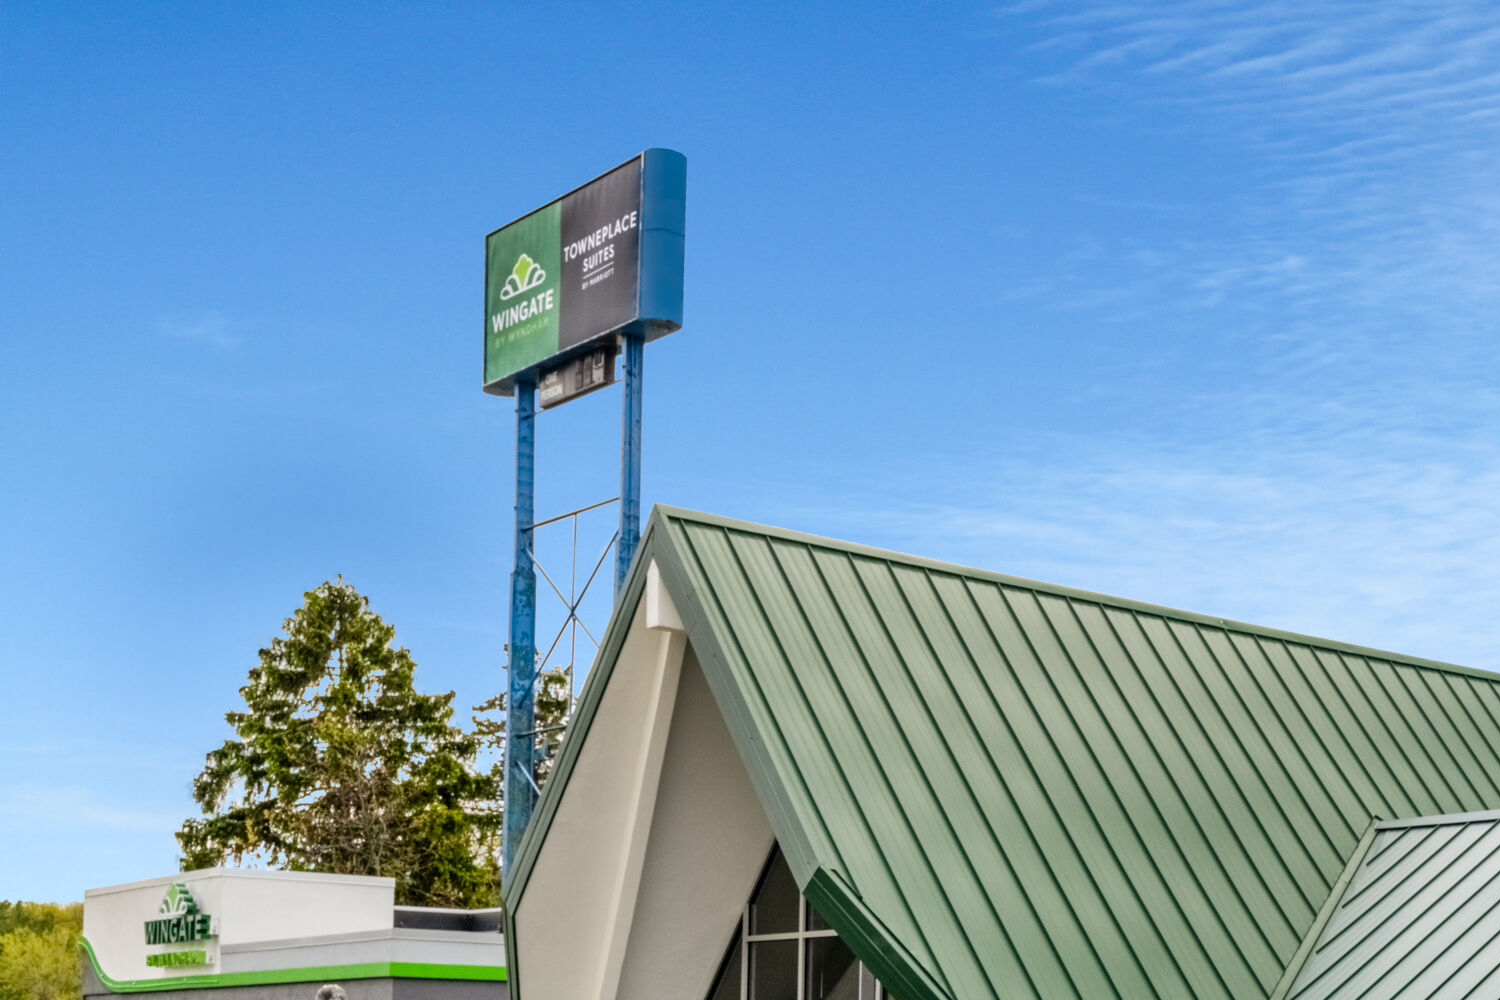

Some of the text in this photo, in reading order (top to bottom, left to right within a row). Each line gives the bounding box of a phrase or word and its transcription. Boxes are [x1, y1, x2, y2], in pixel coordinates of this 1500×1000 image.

[563, 211, 637, 262] TOWNEPLACE
[582, 244, 615, 272] SUITES
[492, 289, 554, 333] WINGATE
[144, 914, 208, 945] WINGATE
